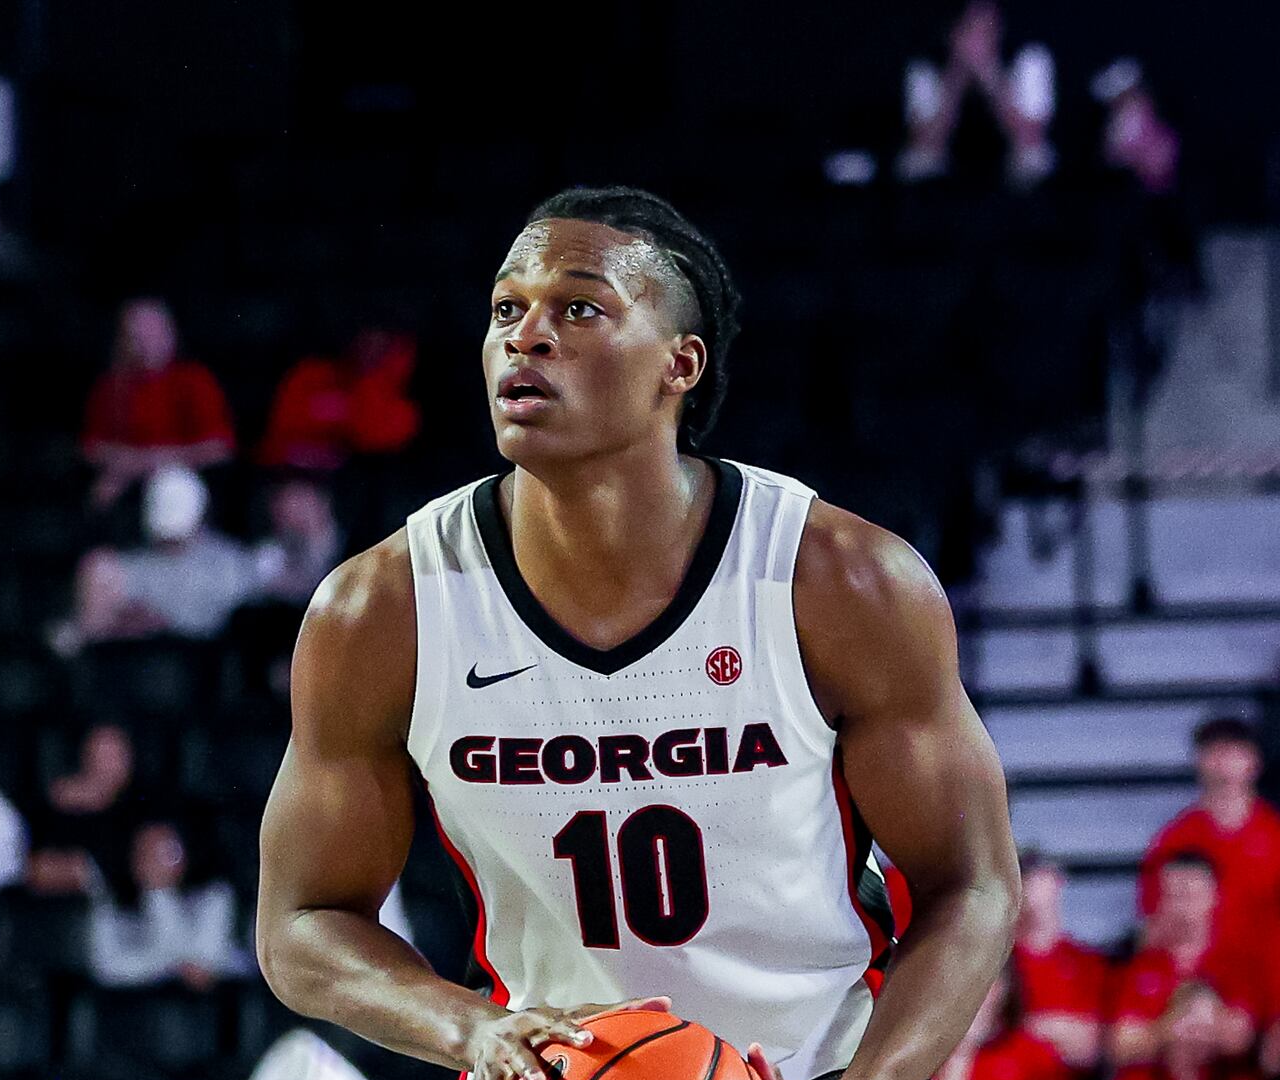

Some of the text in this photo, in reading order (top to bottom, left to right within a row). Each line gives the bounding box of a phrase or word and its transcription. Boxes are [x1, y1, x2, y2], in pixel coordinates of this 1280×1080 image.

[708, 649, 740, 683] SEC
[449, 721, 789, 786] GEORGIA
[553, 804, 709, 949] 10
